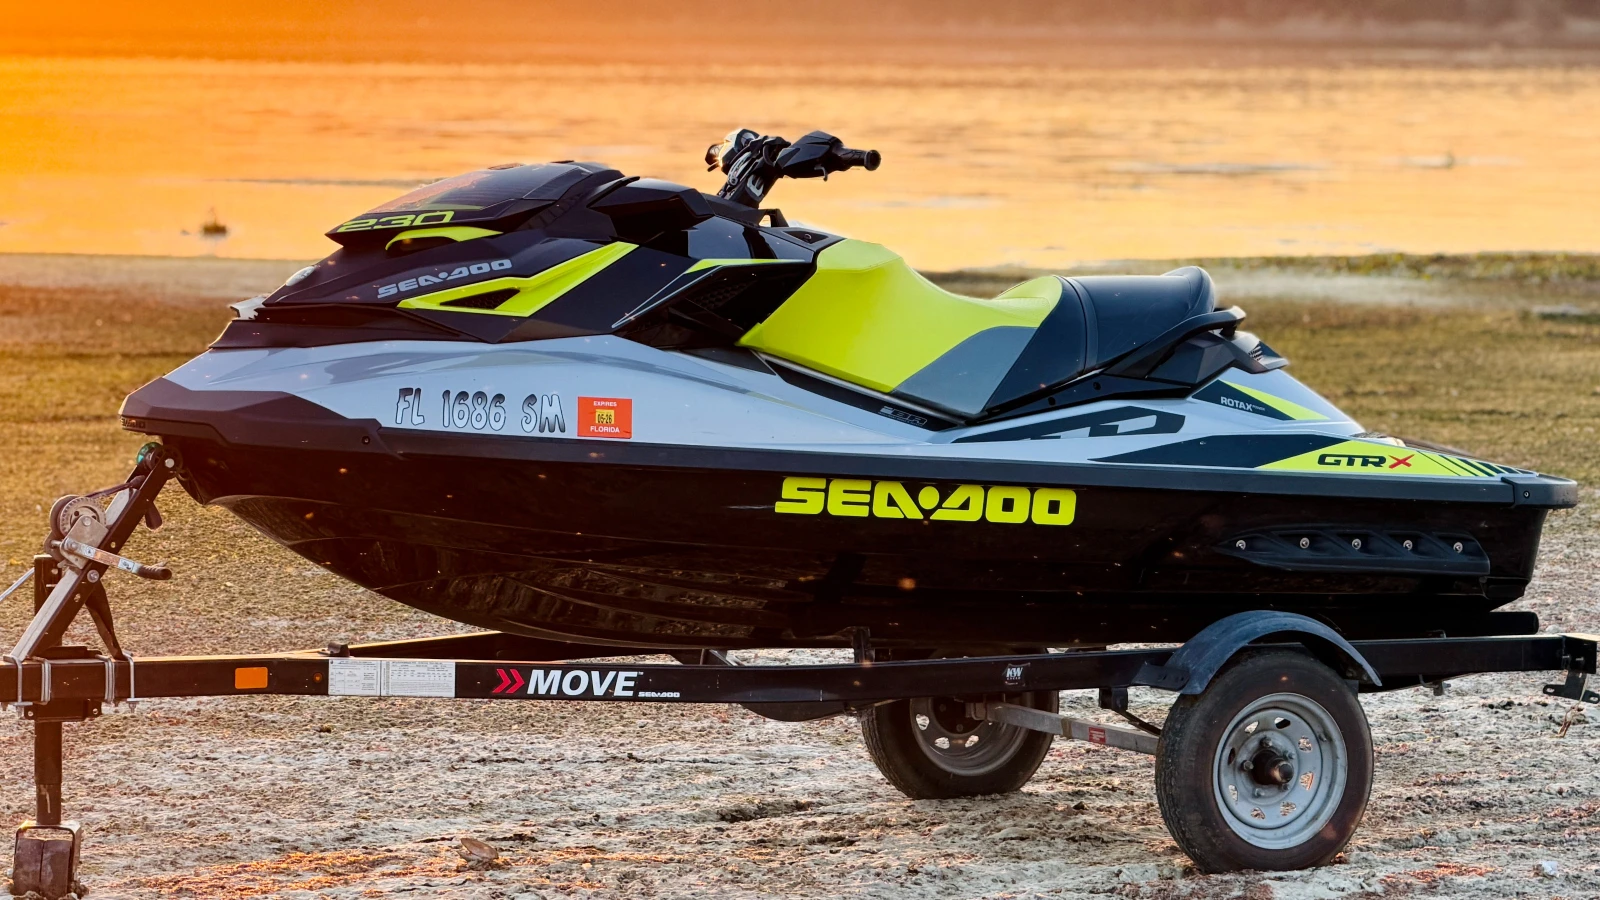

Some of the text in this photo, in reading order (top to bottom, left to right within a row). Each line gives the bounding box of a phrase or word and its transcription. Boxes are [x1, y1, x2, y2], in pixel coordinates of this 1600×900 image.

[337, 210, 455, 233] 230
[394, 387, 566, 434] FL 1686 SM
[1220, 396, 1253, 411] ROTAX
[597, 414, 612, 424] 05-26
[590, 425, 620, 433] FLORIDA
[526, 669, 639, 698] MOVE
